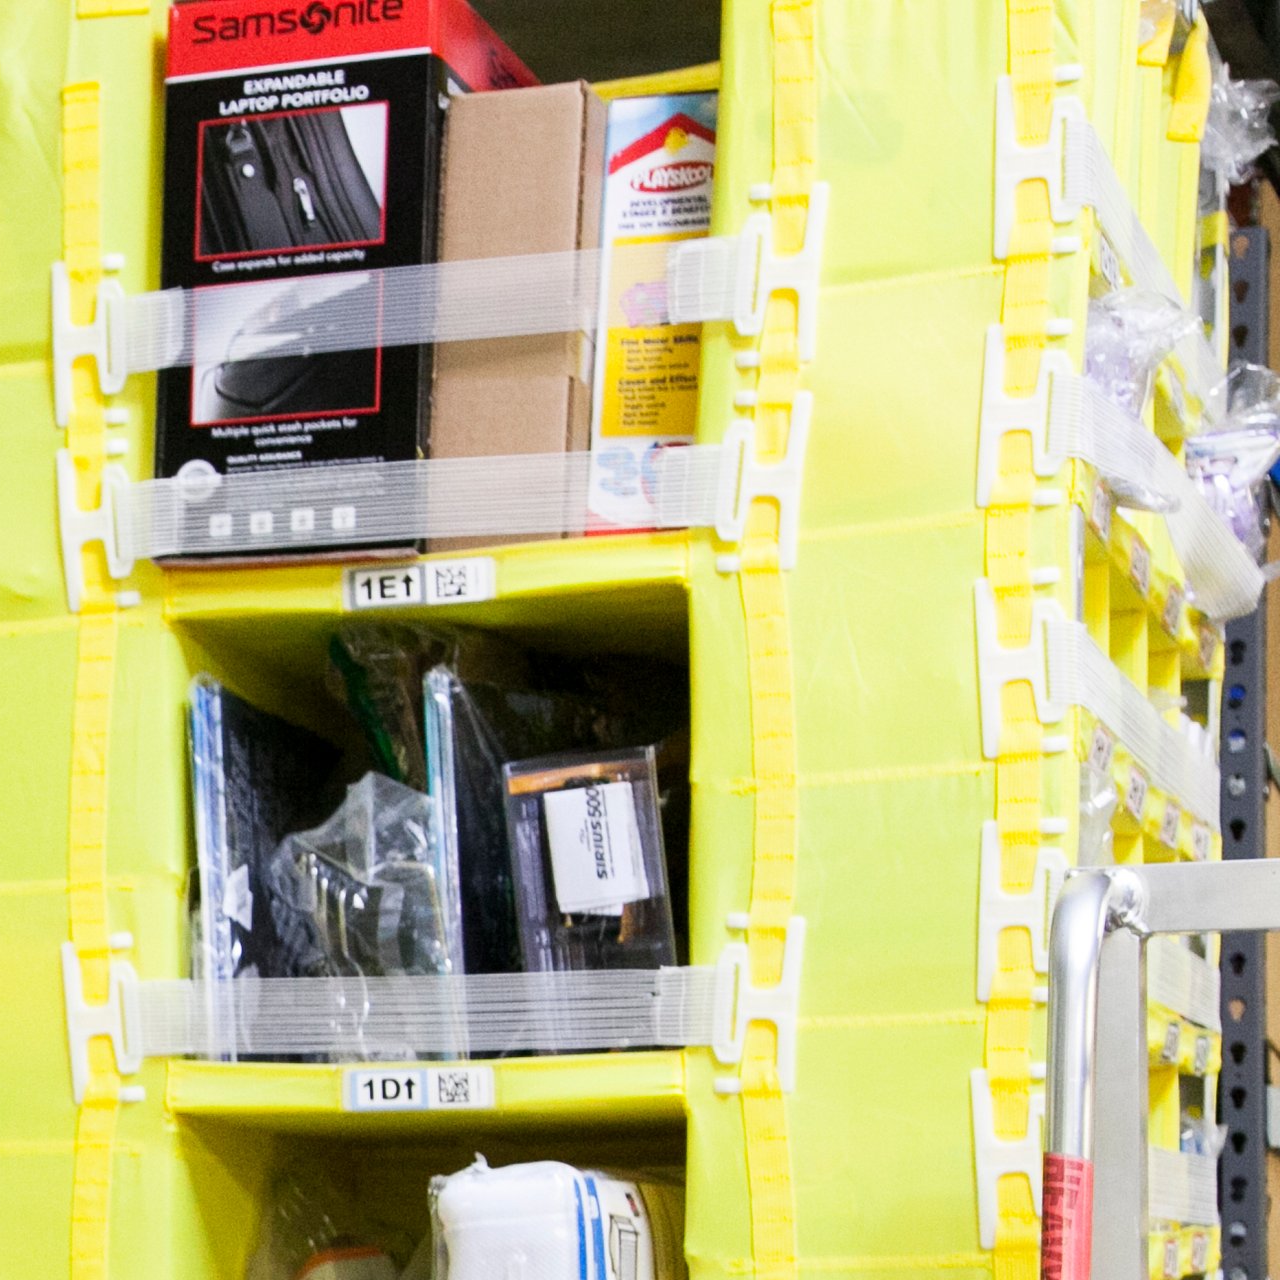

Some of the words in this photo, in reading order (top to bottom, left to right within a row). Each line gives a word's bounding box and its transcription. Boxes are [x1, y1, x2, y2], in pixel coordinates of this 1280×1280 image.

[243, 69, 346, 96] EXPANDABLE
[218, 92, 280, 116] LAPTOP
[281, 84, 370, 110] PORTFOLIO
[212, 260, 236, 273] Case
[237, 255, 277, 271] expands
[293, 250, 325, 266] added
[326, 247, 367, 263] capacity
[211, 426, 249, 441] Multiple
[251, 422, 276, 437] quick
[303, 418, 341, 433] pockets
[361, 576, 396, 600] 1E
[364, 1078, 400, 1100] 1D
